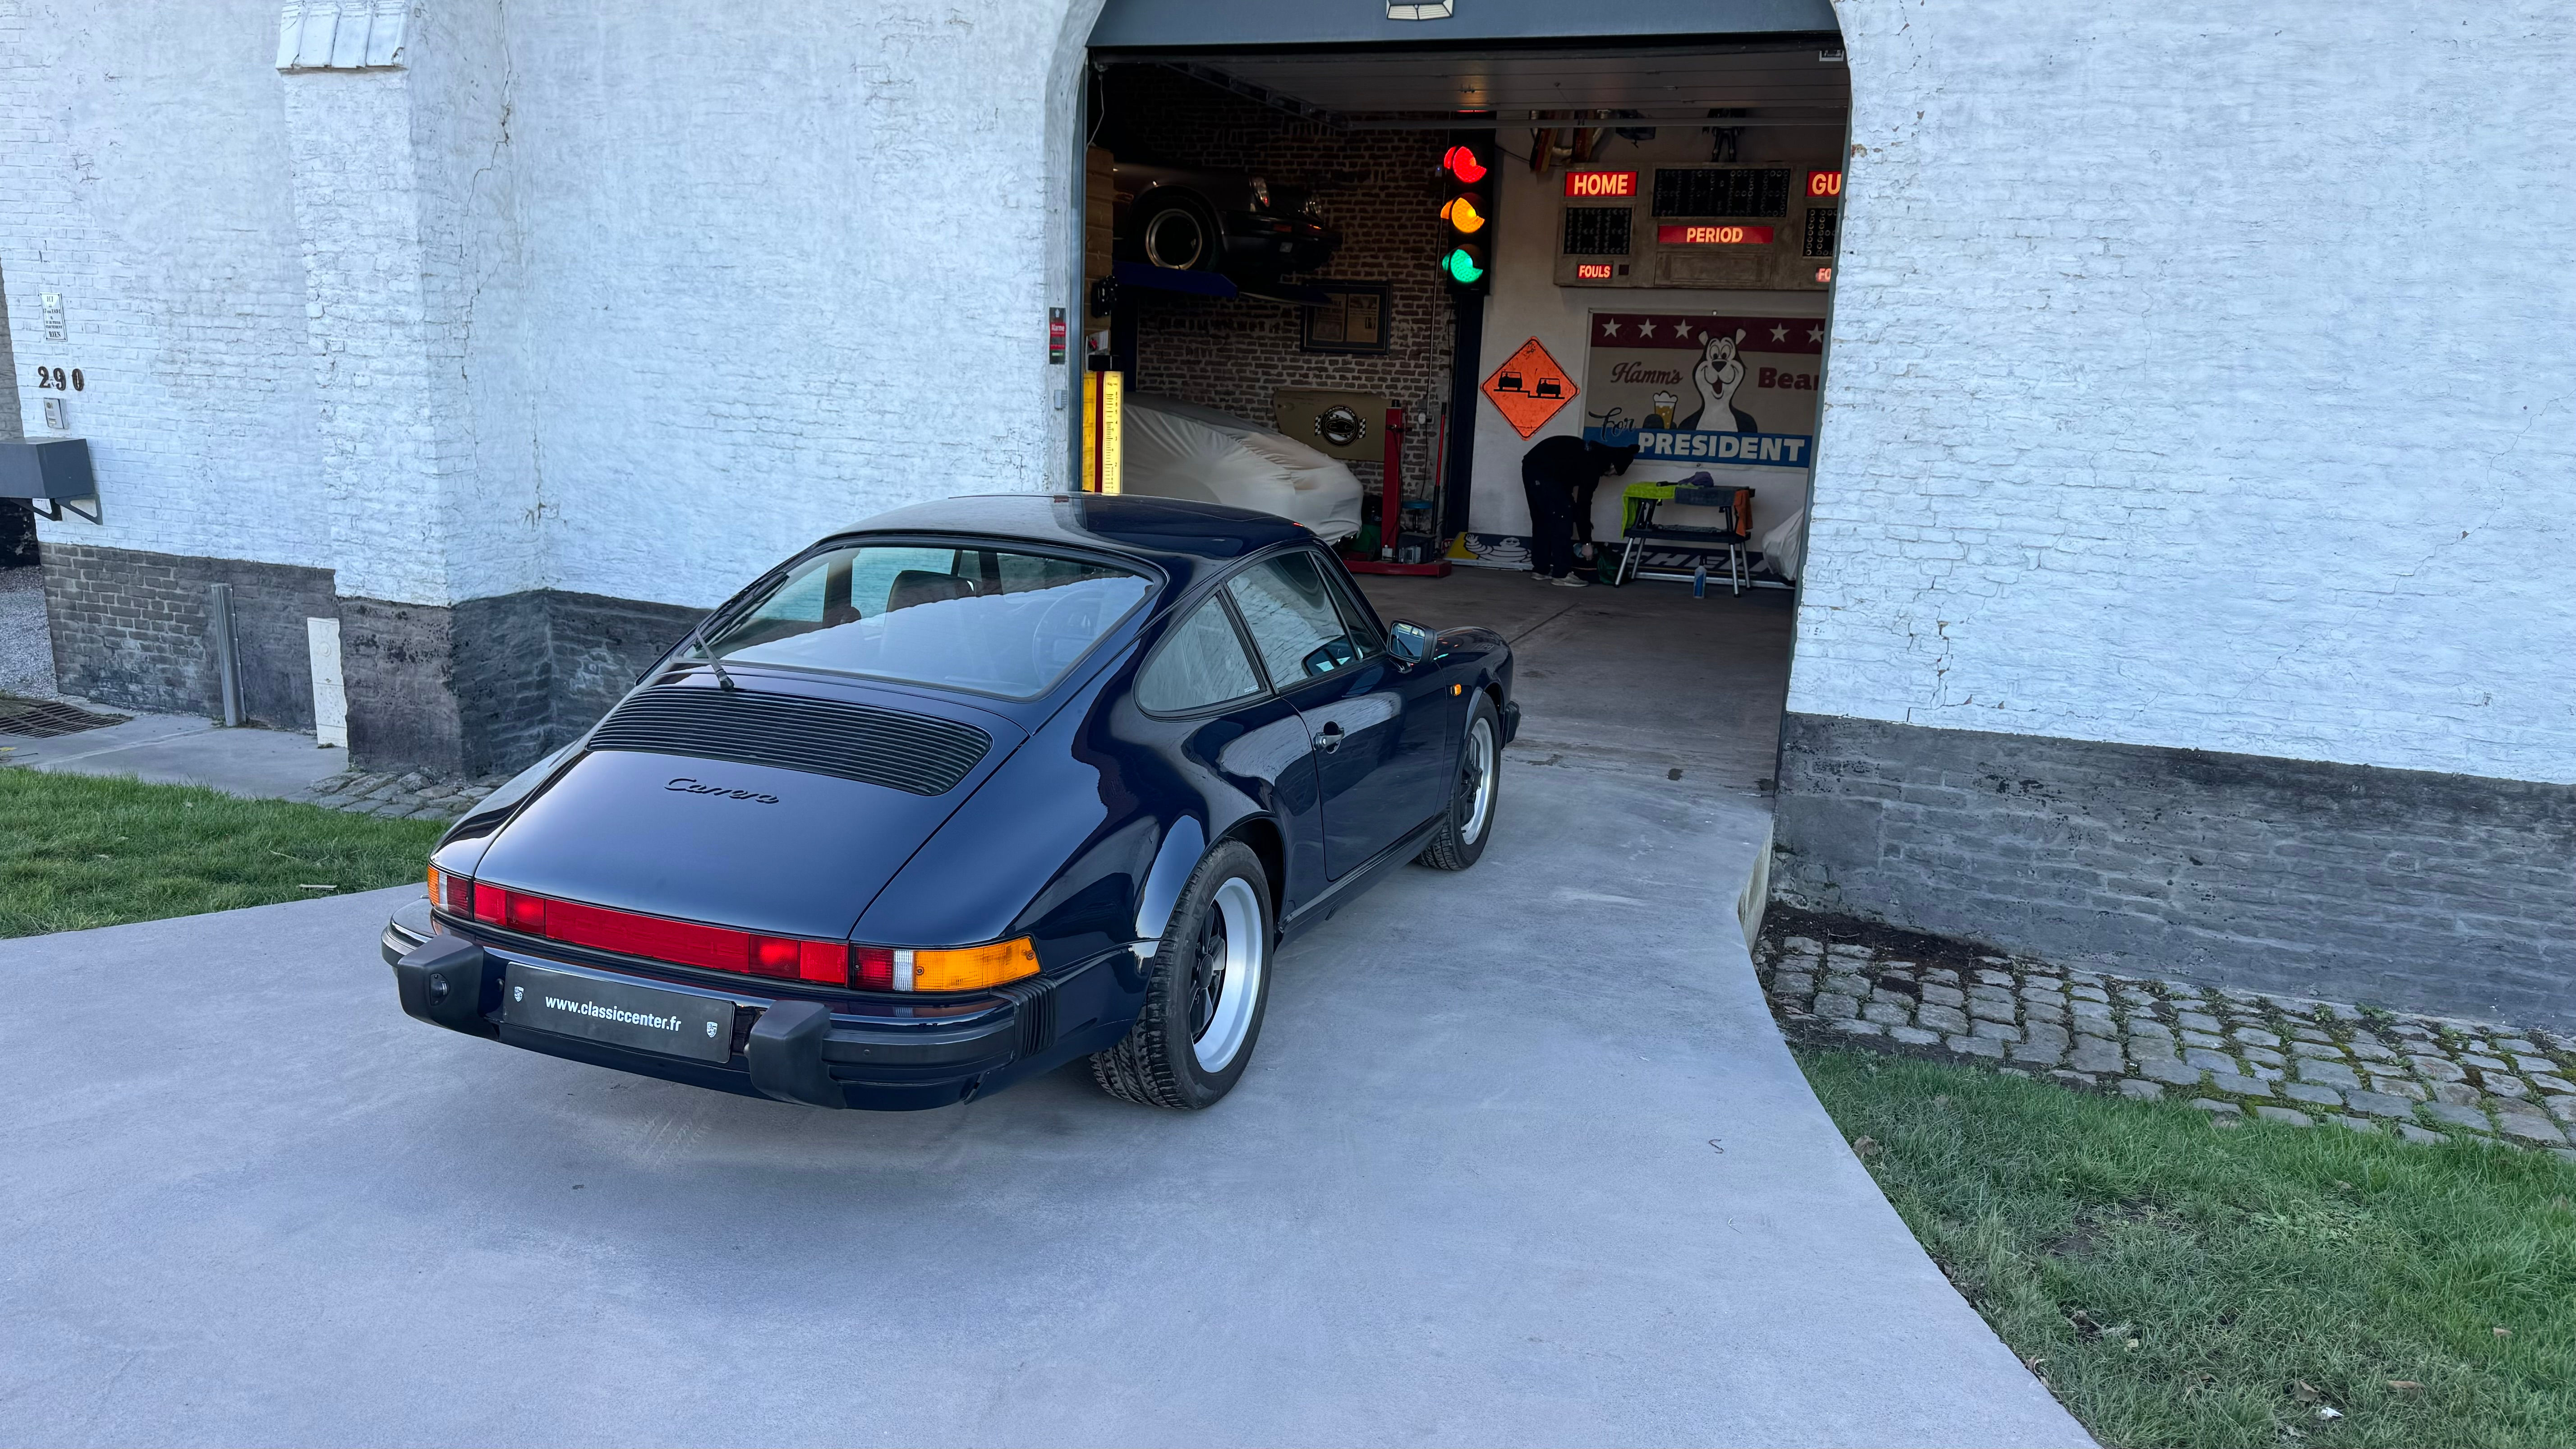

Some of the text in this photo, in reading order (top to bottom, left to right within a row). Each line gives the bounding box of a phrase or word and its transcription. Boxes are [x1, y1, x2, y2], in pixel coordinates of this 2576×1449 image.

[1574, 174, 1628, 195] HOME
[1687, 227, 1743, 243] PERIOD
[1579, 265, 1610, 278] FOULS
[38, 366, 84, 391] 290
[1610, 361, 1683, 385] Hamm's
[1588, 407, 1636, 442] For
[1638, 432, 1805, 461] PRESIDENT
[664, 778, 779, 804] Carrera
[545, 996, 681, 1031] www.classiccenter.fr
